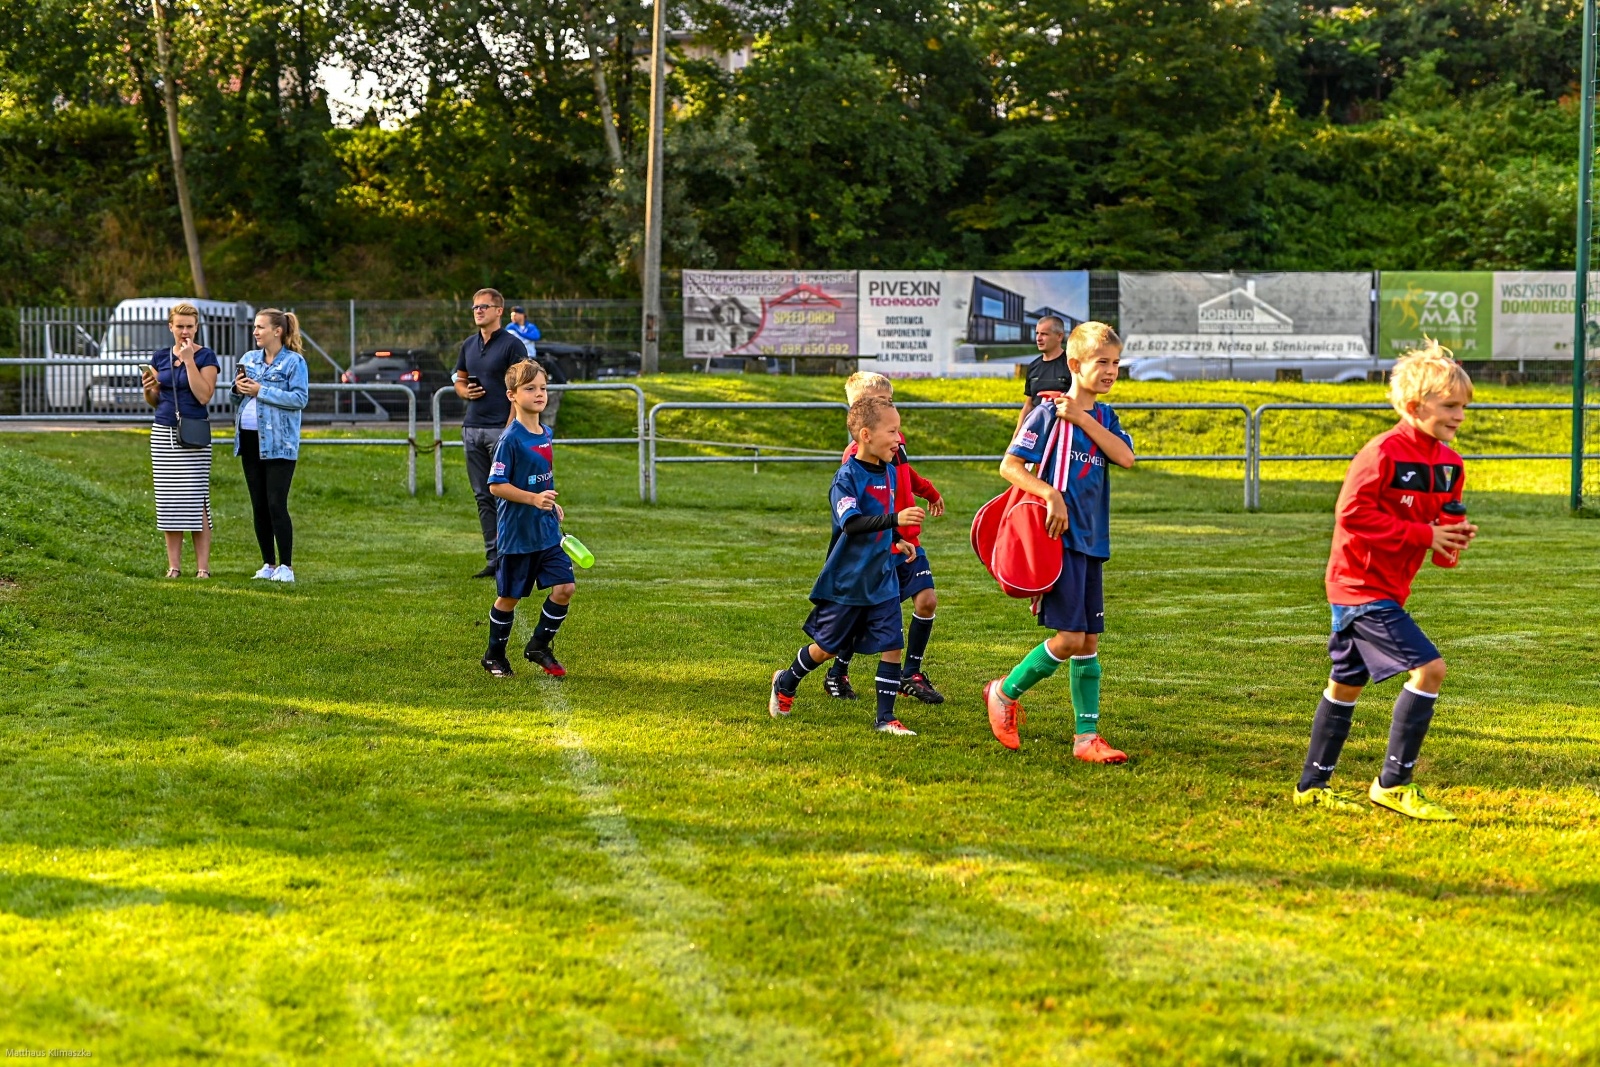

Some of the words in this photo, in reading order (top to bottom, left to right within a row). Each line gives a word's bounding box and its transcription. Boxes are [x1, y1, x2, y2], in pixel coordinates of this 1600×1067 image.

[795, 273, 854, 284] DEKARSKIE
[869, 281, 941, 296] PIVEXIN
[1501, 284, 1567, 298] WSZYSTKO
[870, 297, 940, 307] TECHNOLOGY
[1423, 291, 1479, 308] ZOO
[1501, 299, 1576, 314] DOMOWEGO
[885, 315, 924, 325] DOSTAWCA
[1200, 308, 1253, 320] DORBUD
[1419, 309, 1477, 325] MAR
[877, 328, 932, 337] KOMPONENTÓW
[780, 343, 802, 355] 698
[828, 343, 849, 355] 692
[886, 339, 928, 351] ROZWIĄZAŃ
[1127, 341, 1144, 351] tel.
[1148, 341, 1169, 351] 602
[1255, 341, 1269, 351] ul.
[1272, 341, 1343, 351] Sienkiewicza
[876, 353, 889, 362] DLA
[891, 353, 933, 362] PRZEMYSŁU
[1400, 495, 1414, 508] MJ
